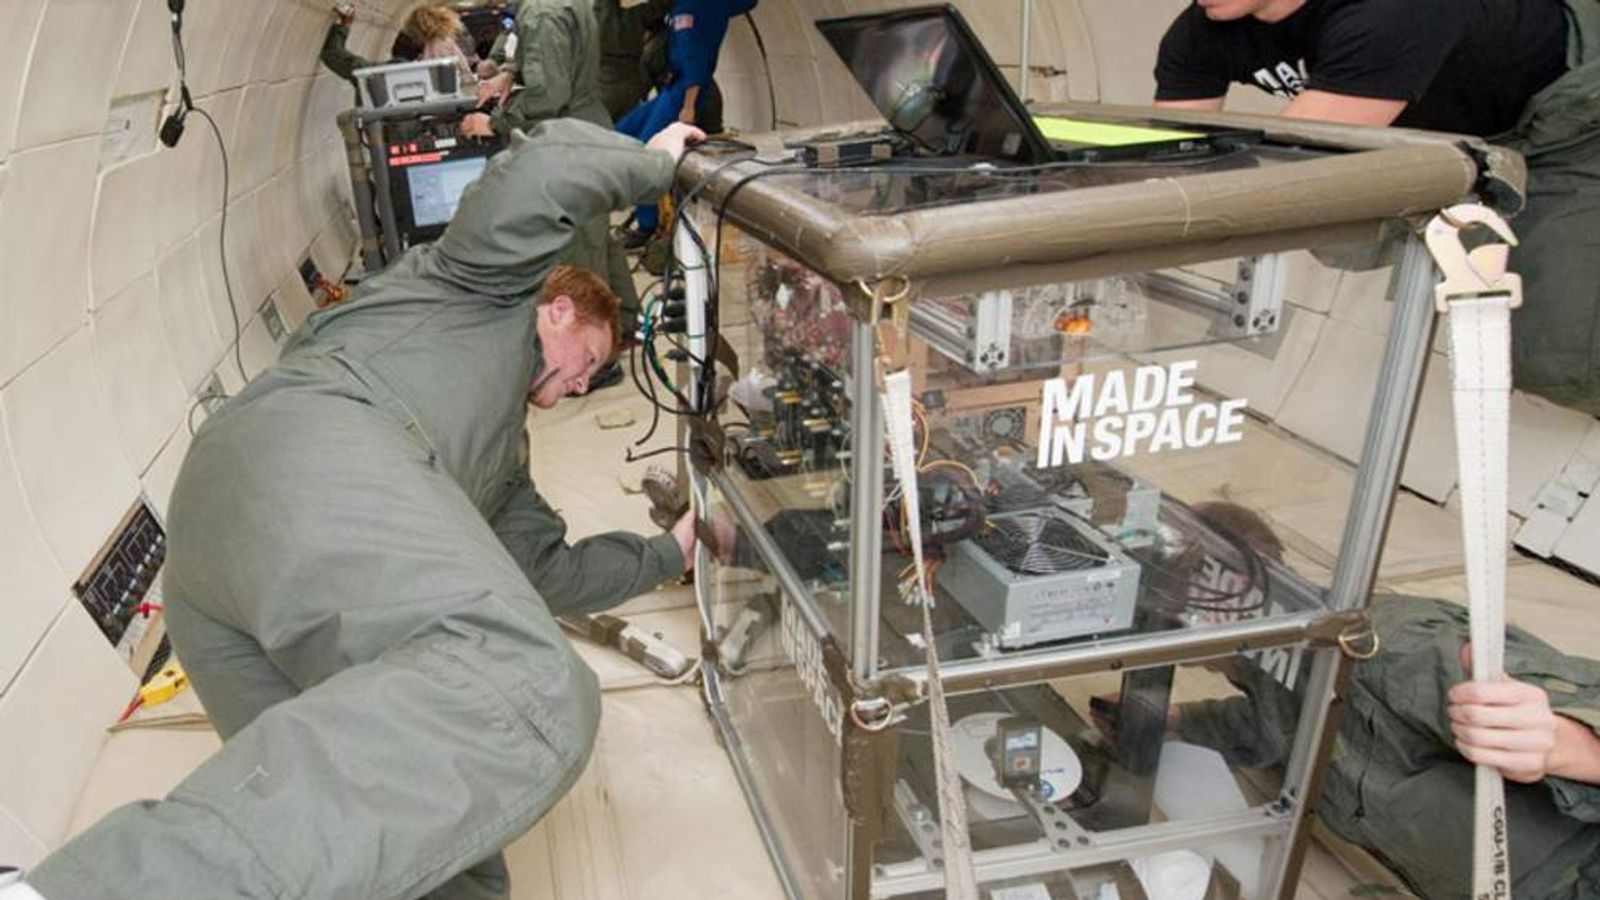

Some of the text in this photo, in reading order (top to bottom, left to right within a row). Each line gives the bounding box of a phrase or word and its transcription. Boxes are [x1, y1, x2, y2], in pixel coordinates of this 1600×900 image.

[1043, 360, 1197, 423] MADE
[1037, 398, 1248, 468] IN SPACE
